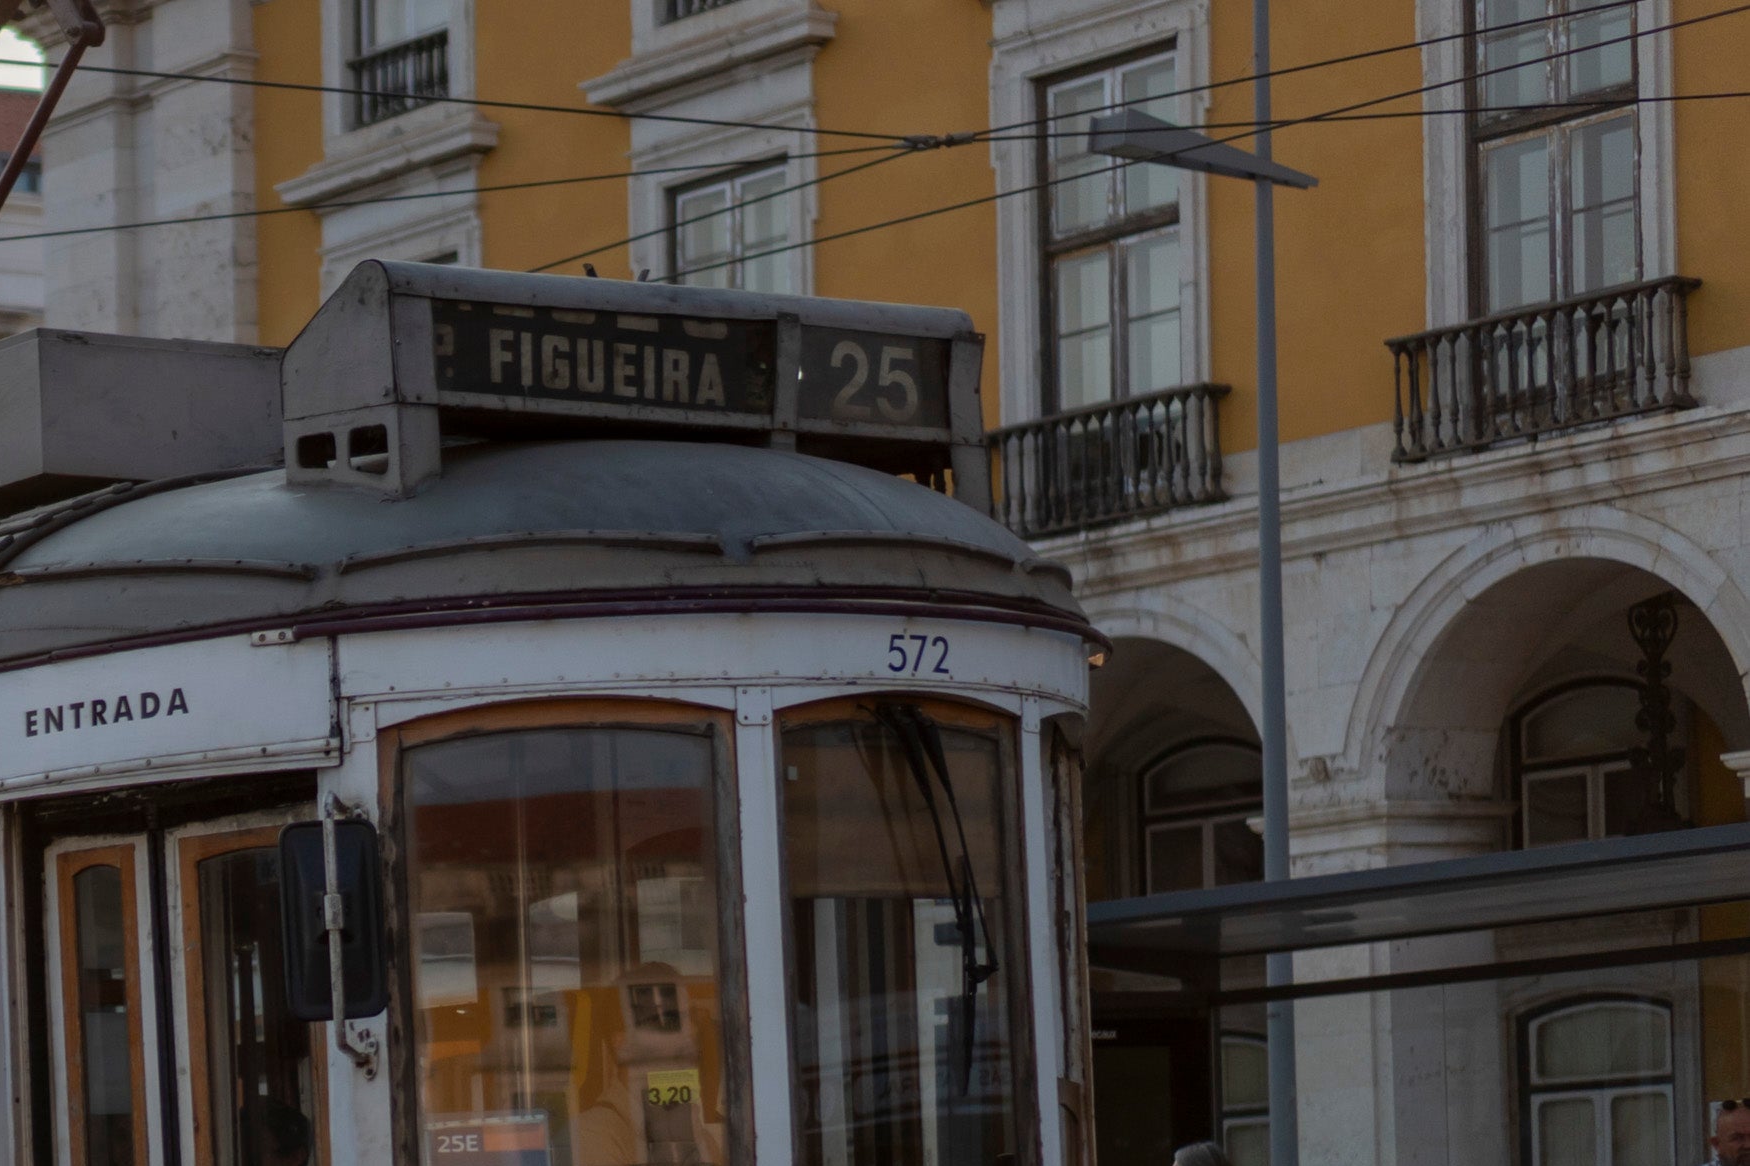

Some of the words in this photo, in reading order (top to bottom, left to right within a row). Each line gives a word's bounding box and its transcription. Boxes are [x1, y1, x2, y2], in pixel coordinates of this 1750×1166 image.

[488, 328, 726, 407] FIGUEIRA
[828, 340, 919, 422] 25
[888, 633, 950, 674] 572
[25, 687, 189, 738] ENTRADA
[437, 1134, 479, 1153] 25E
